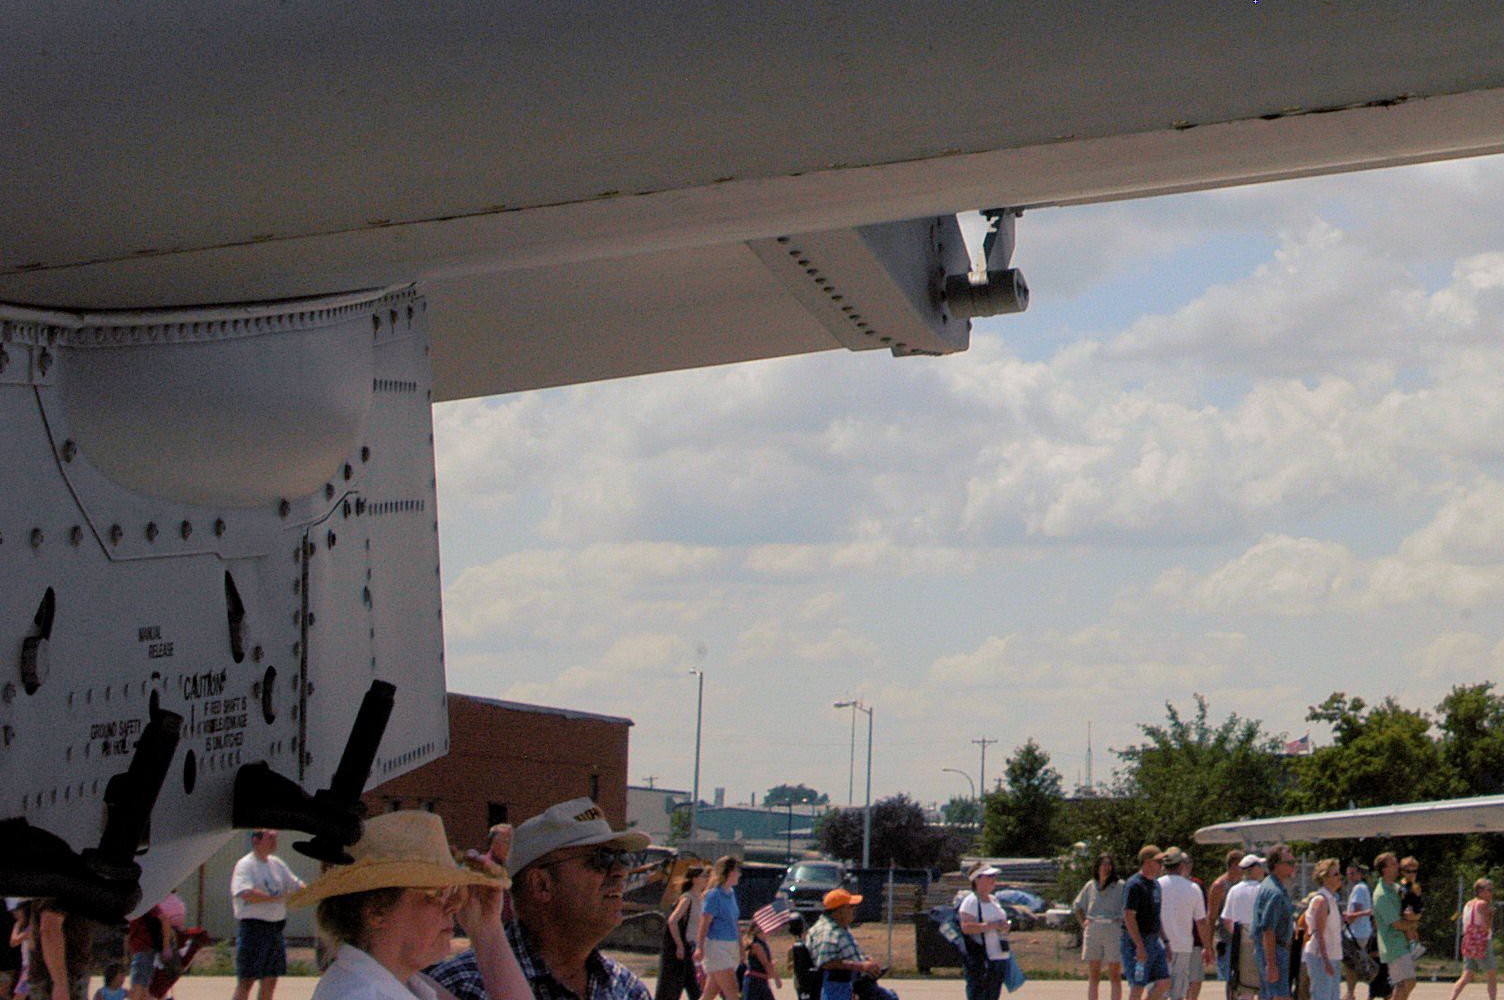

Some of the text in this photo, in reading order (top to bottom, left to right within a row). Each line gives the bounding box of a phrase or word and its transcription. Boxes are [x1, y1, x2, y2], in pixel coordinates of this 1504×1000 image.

[149, 642, 174, 659] RELEASE
[90, 719, 142, 740] GROUND SAFETY
